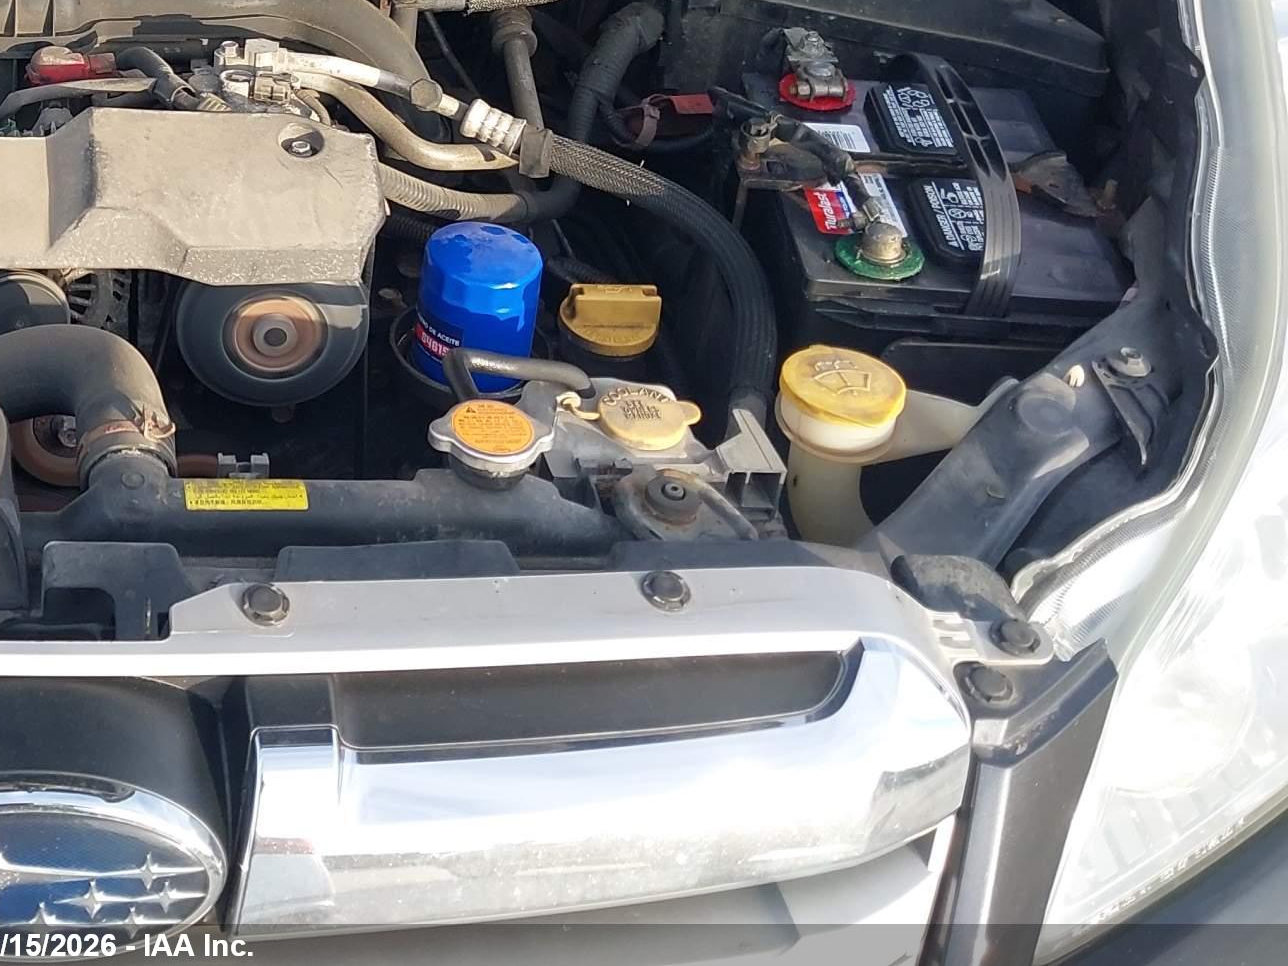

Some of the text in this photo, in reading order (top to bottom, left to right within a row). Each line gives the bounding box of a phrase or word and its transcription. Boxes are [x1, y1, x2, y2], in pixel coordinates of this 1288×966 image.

[923, 185, 941, 209] POISON
[813, 192, 838, 230] Duralast
[936, 214, 956, 241] DANGER
[437, 332, 460, 347] ACEITE
[601, 387, 670, 406] COOLANT
